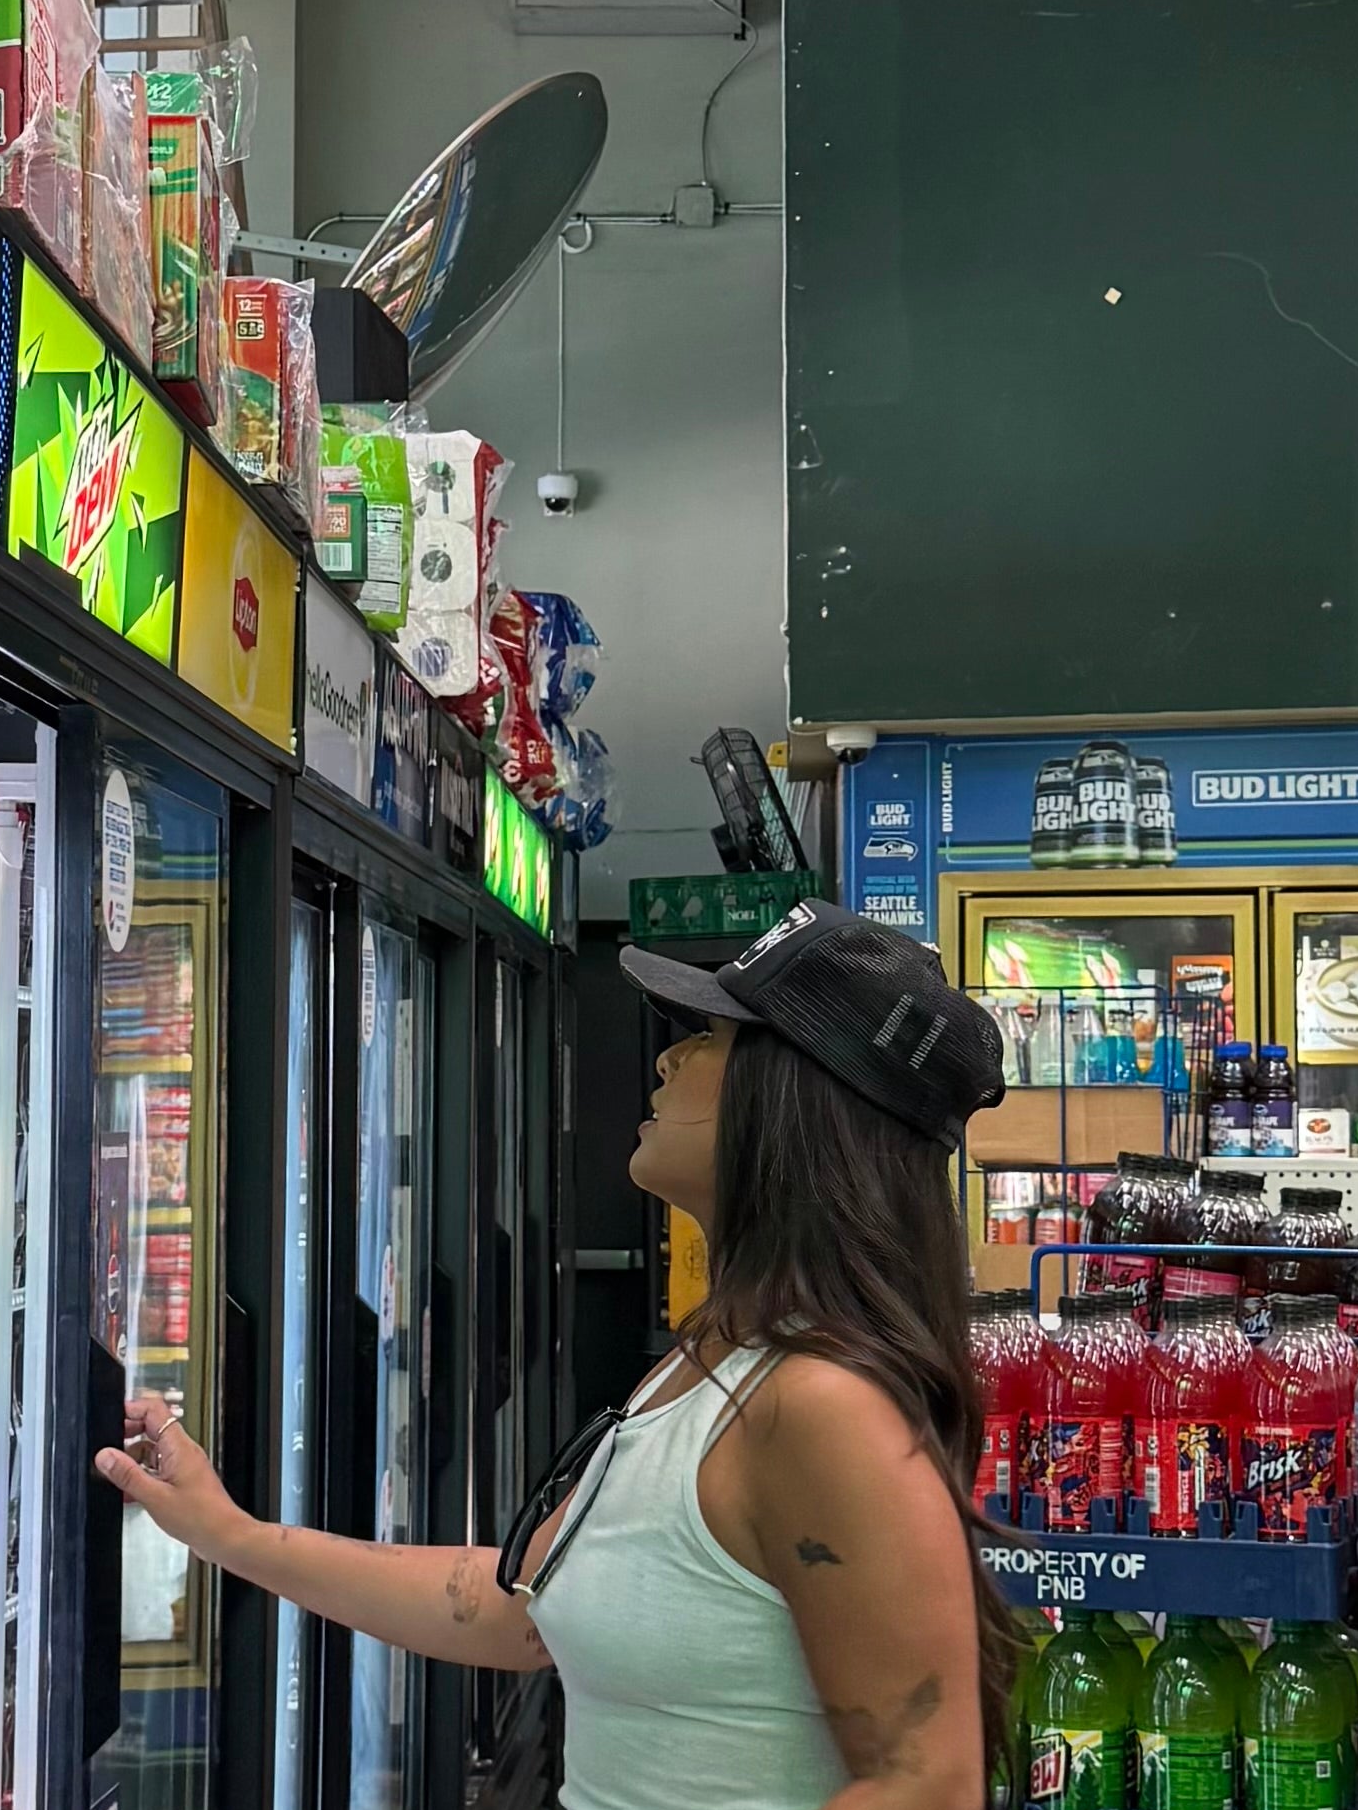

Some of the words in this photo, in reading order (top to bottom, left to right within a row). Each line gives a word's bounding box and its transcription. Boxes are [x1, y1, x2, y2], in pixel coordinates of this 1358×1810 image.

[943, 762, 952, 802] LIGHT
[1079, 782, 1129, 801] BUD
[1199, 776, 1266, 801] BUD
[871, 813, 911, 826] LIGHT
[875, 804, 905, 816] BUD
[943, 803, 952, 832] BUD
[1074, 802, 1136, 823] LIGHT
[865, 896, 917, 910] SEATTLE
[981, 1549, 1107, 1575] PROPERTY
[1112, 1554, 1145, 1579] OF
[1038, 1574, 1085, 1602] PNB
